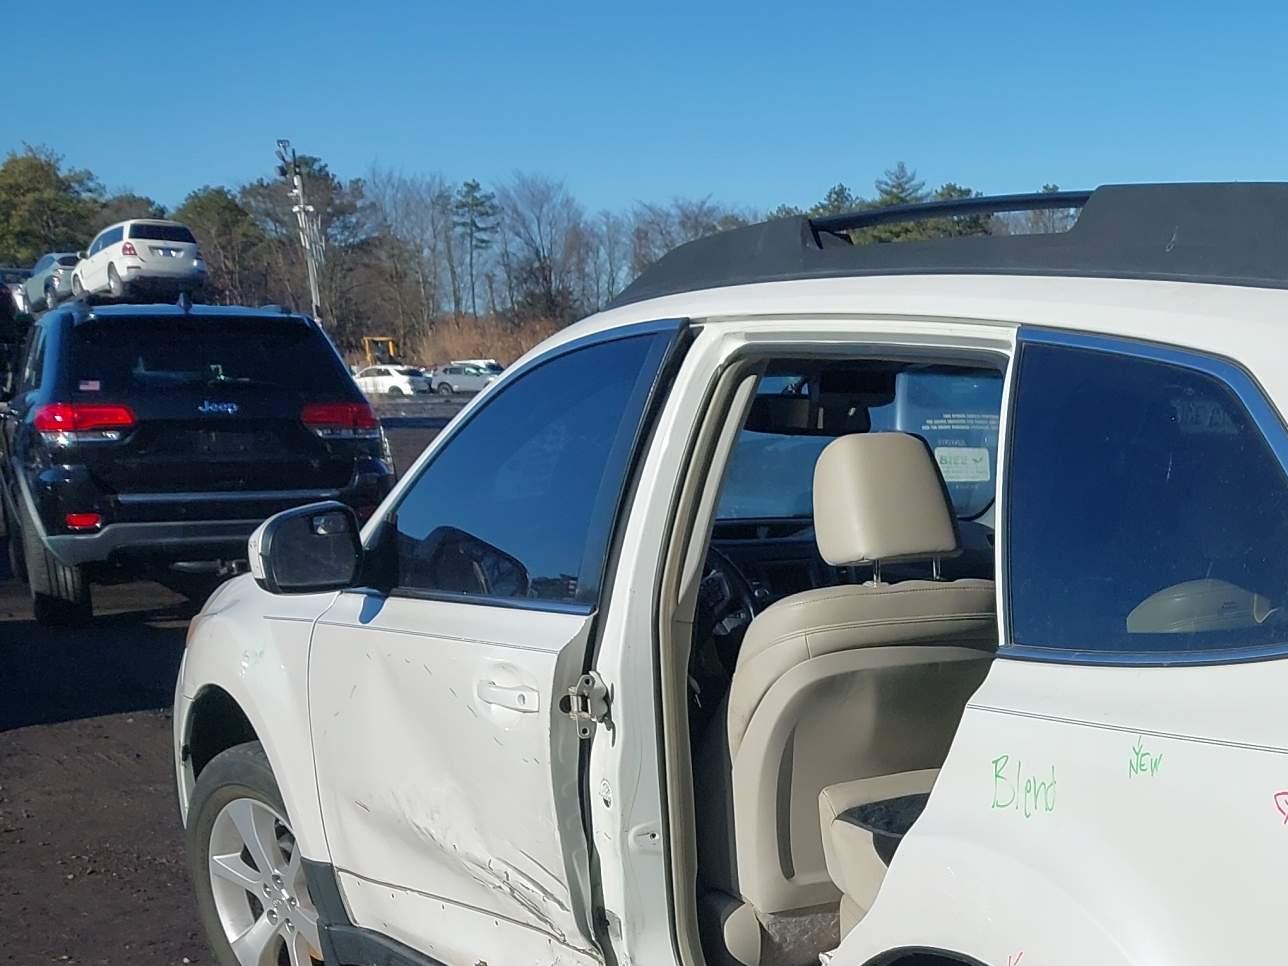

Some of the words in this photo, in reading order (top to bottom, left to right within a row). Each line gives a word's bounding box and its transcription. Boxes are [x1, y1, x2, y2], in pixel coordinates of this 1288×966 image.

[197, 400, 239, 415] Jeep
[1128, 752, 1163, 779] NEW
[991, 755, 1057, 818] Blend
